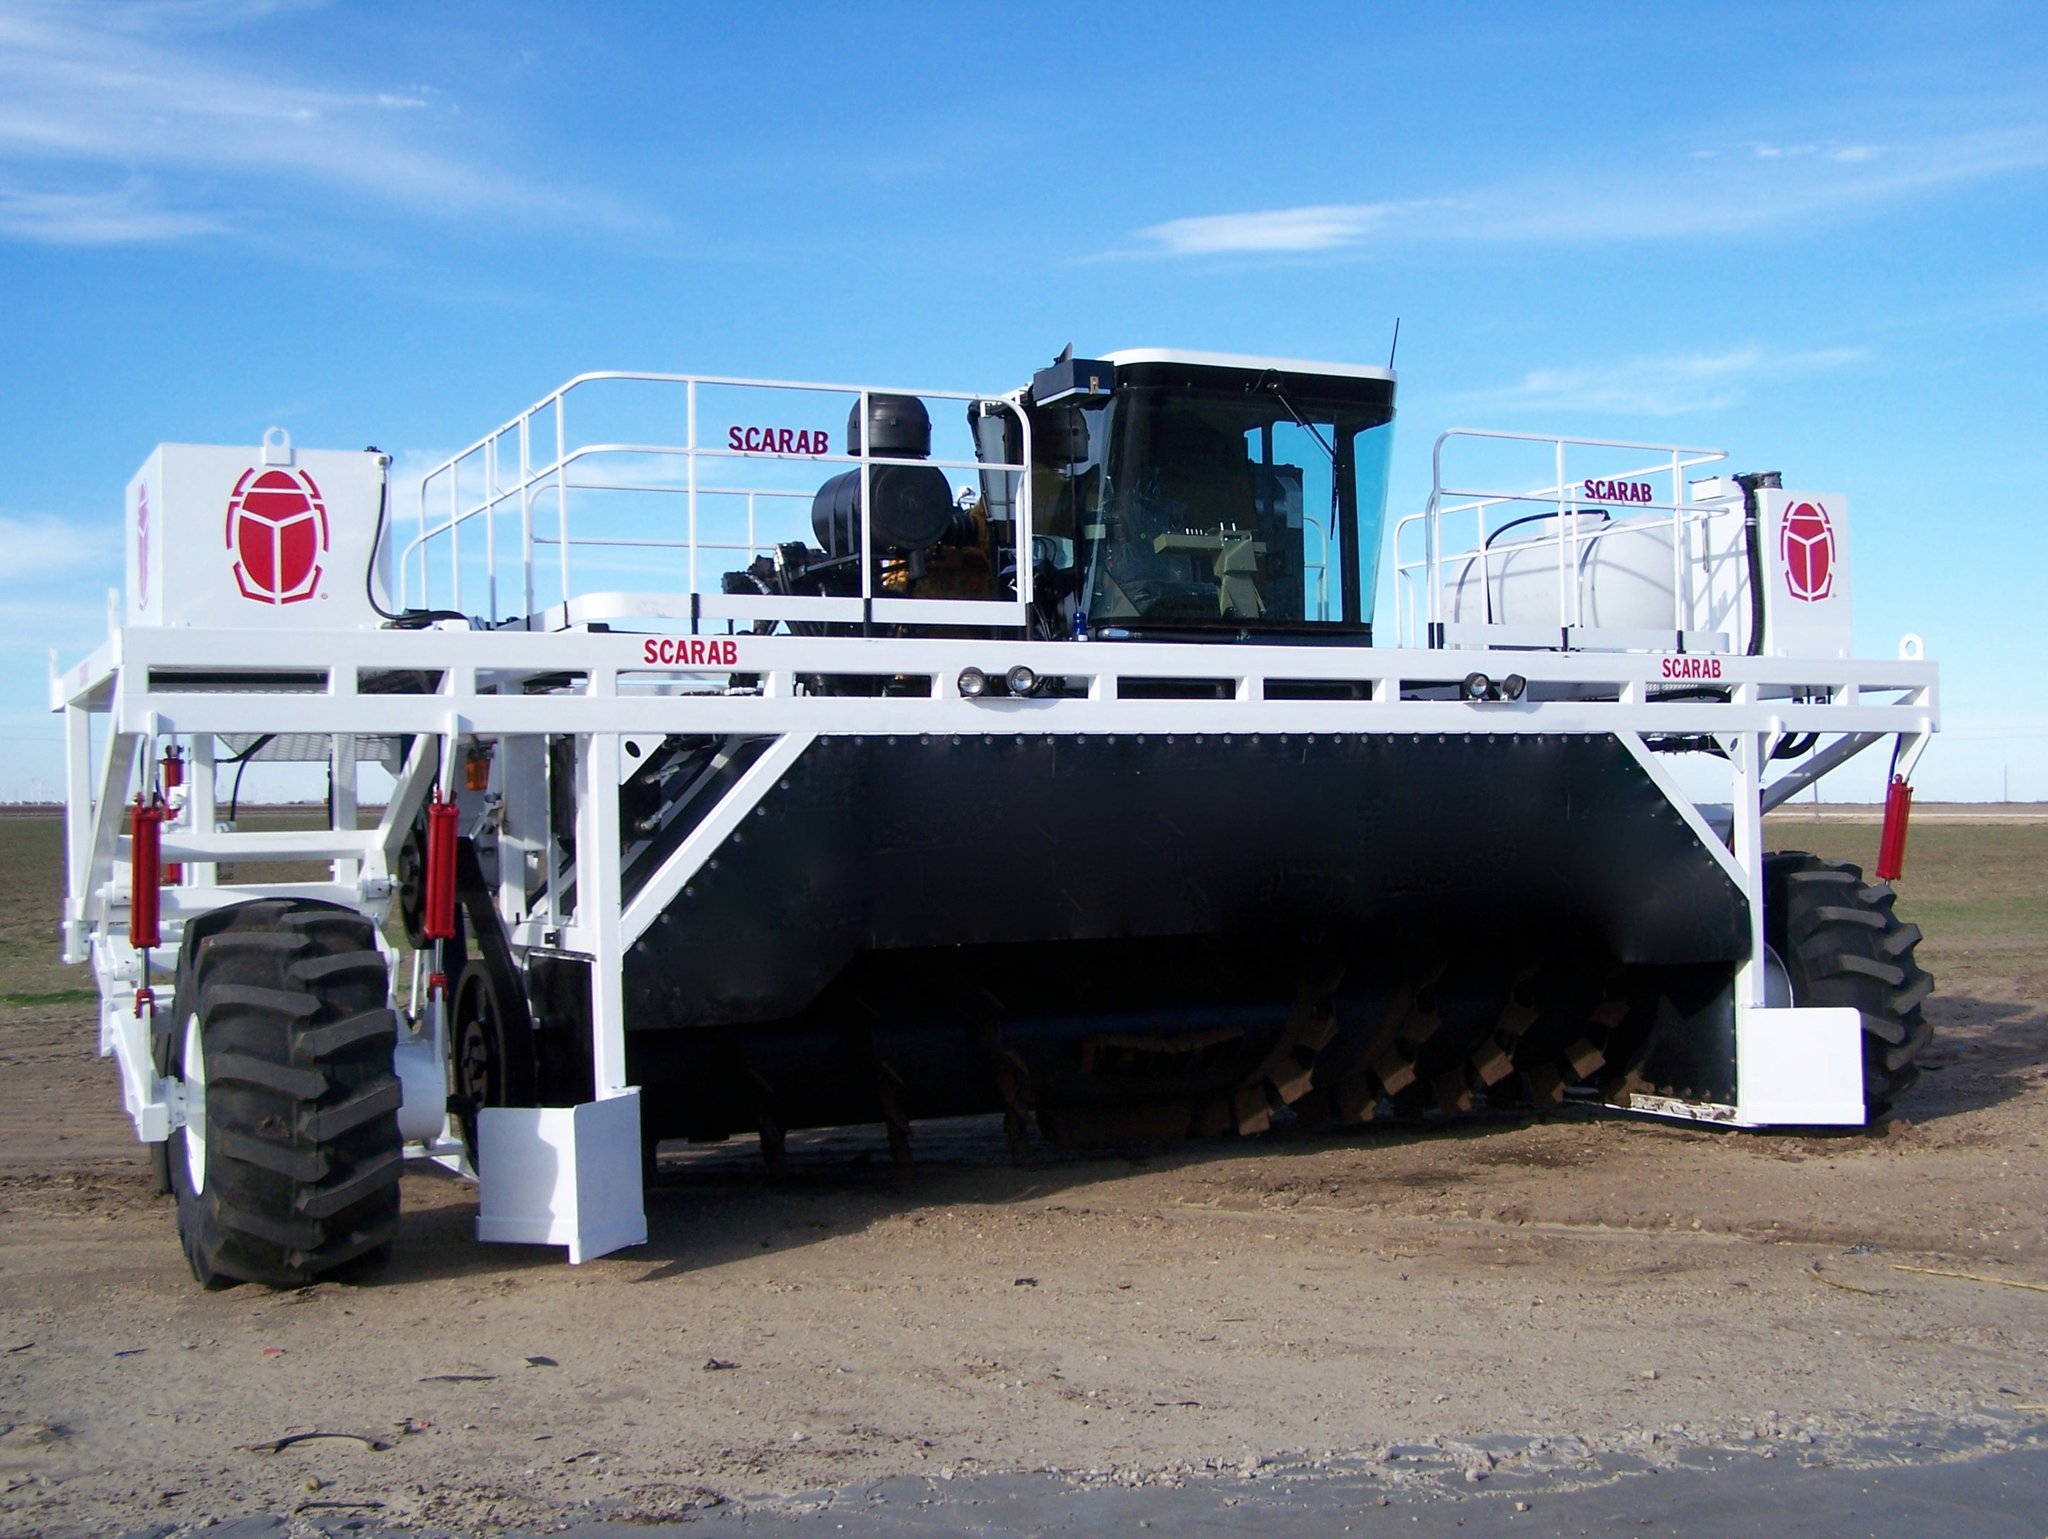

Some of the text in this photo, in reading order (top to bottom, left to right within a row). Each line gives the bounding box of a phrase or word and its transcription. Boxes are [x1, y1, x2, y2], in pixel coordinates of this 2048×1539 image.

[729, 426, 829, 455] SCARAB
[1585, 480, 1651, 502] SCARAB
[644, 639, 737, 665] SCARAB
[1662, 657, 1721, 679] SCARAB
